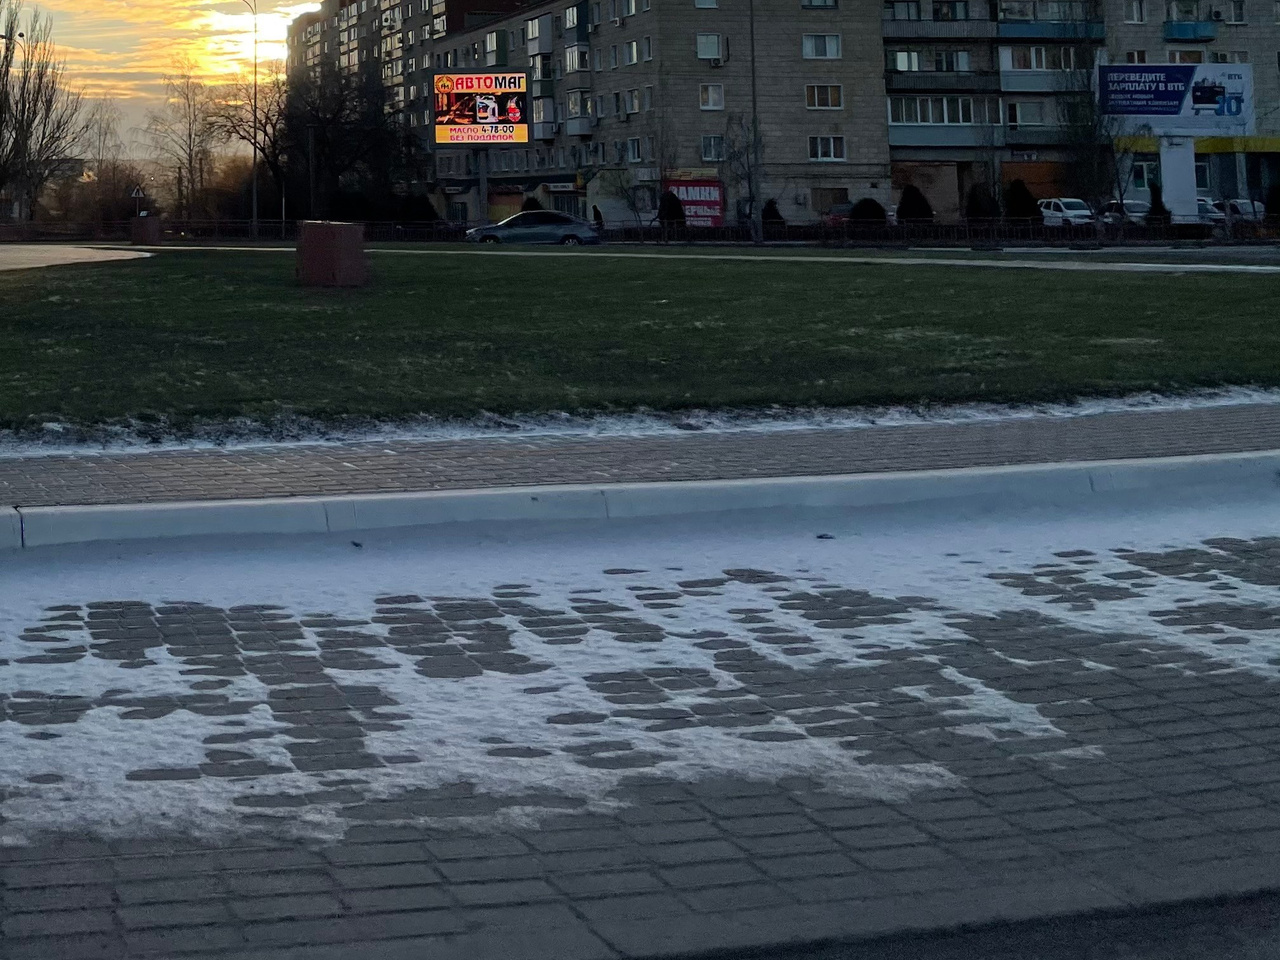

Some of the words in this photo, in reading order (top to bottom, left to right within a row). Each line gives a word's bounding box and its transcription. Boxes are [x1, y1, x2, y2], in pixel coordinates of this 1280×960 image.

[1108, 73, 1166, 82] ПЕРЕВЕДИТЕ
[455, 76, 524, 90] АВТОМАГ
[1108, 82, 1156, 91] ЗАРПЛАТУ
[1159, 83, 1165, 91] В
[1167, 83, 1185, 91] ВТБ
[482, 125, 514, 134] 4-78-00
